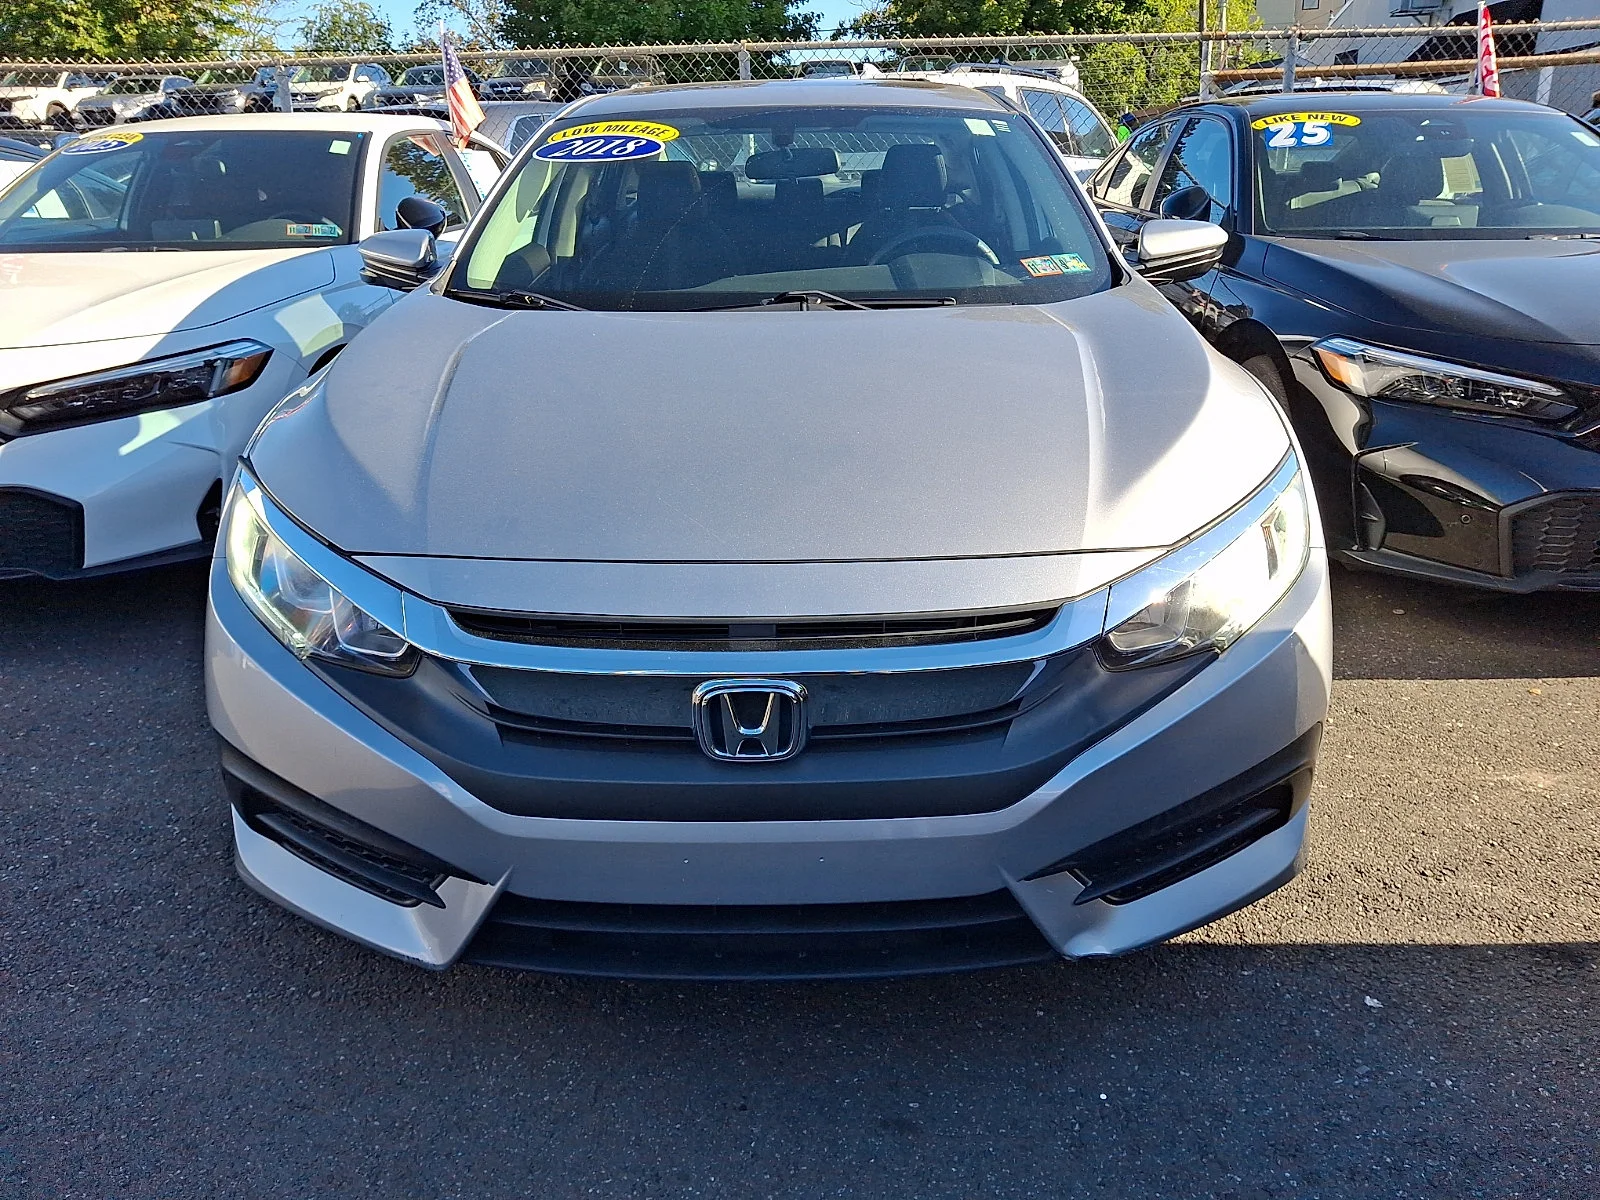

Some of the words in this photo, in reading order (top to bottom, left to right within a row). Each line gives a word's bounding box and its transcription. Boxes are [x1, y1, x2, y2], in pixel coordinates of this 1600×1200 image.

[1262, 114, 1302, 126] LIKE
[1307, 113, 1348, 123] NEW
[560, 125, 599, 138] LOW
[603, 124, 669, 138] MILEAGE
[1268, 121, 1331, 148] 25
[548, 138, 648, 158] 2018
